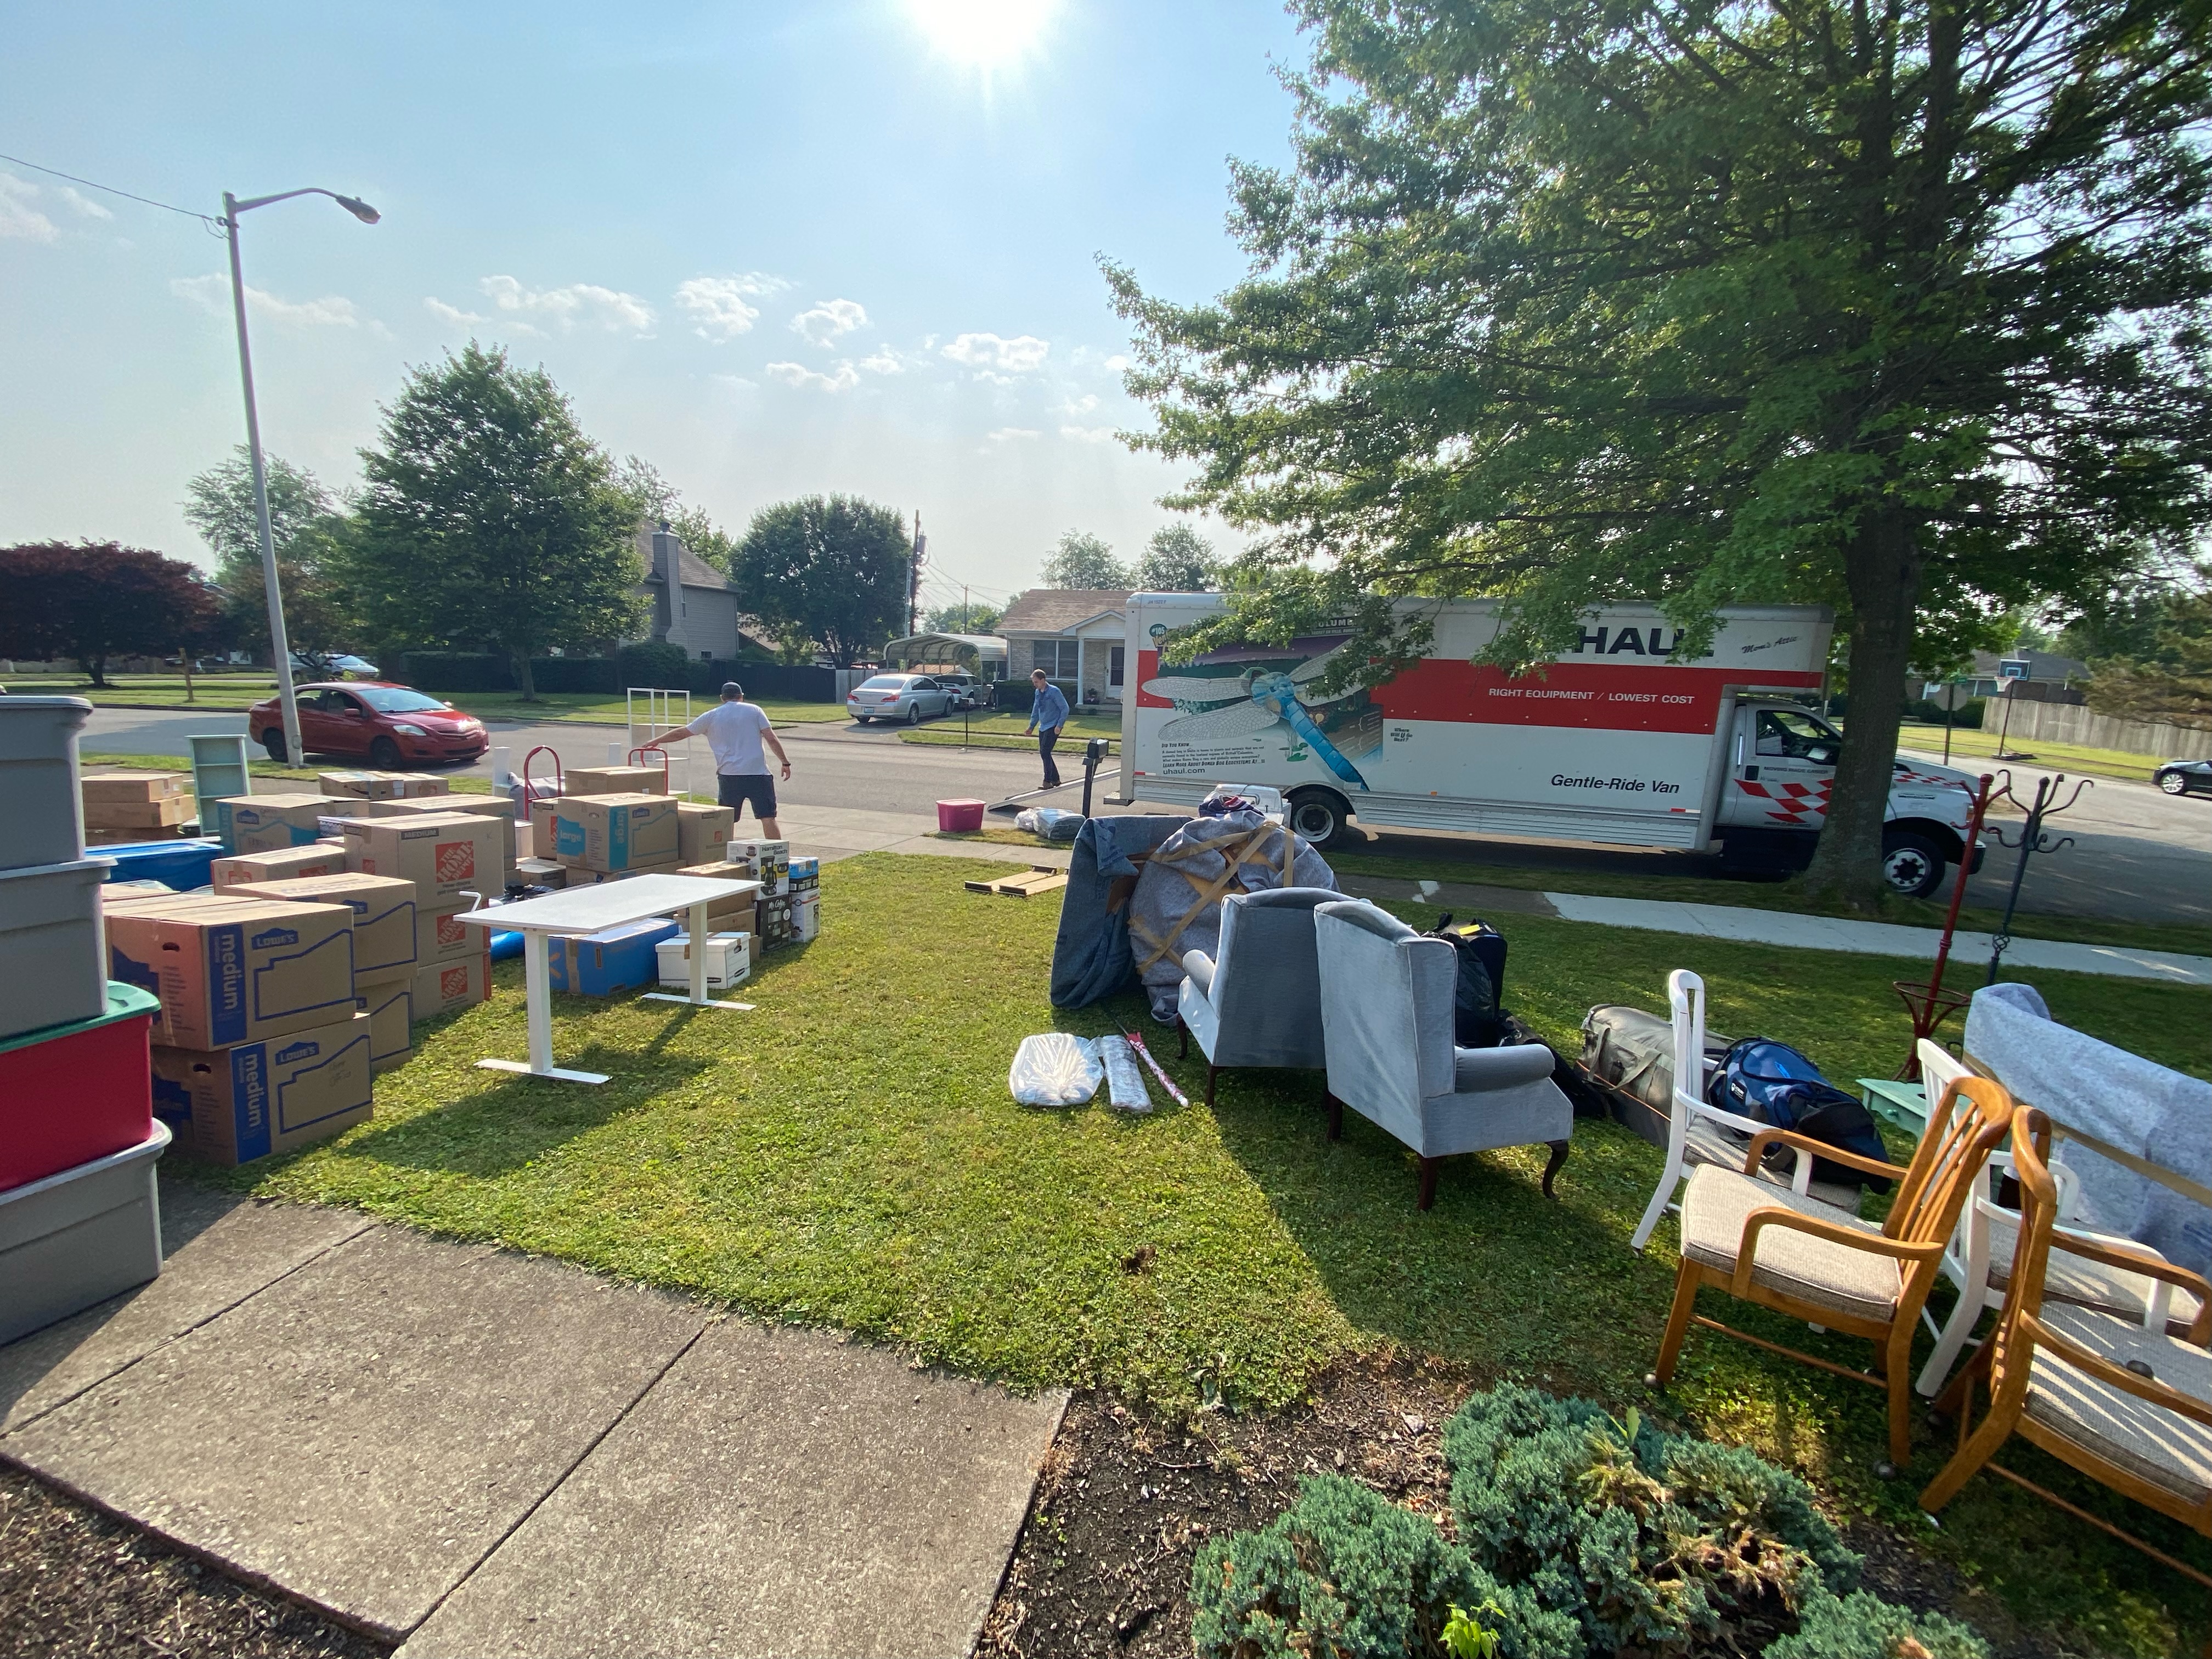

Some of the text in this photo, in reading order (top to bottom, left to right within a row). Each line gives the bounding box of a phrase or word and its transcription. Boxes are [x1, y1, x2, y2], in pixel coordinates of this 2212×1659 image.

[1572, 627, 1714, 657] HAU
[1488, 688, 1523, 698] RIGHT
[1525, 690, 1595, 700] EQUIPMENT
[1608, 693, 1658, 703] LOWEST
[1661, 695, 1695, 704] COST
[1551, 774, 1680, 794] Gentle-Ride Van
[404, 828, 437, 839] MEDIUM
[560, 829, 582, 843] large
[615, 809, 627, 844] large
[221, 934, 243, 1010] medium
[280, 1046, 316, 1063] LOWE'S
[245, 1053, 265, 1128] medium
